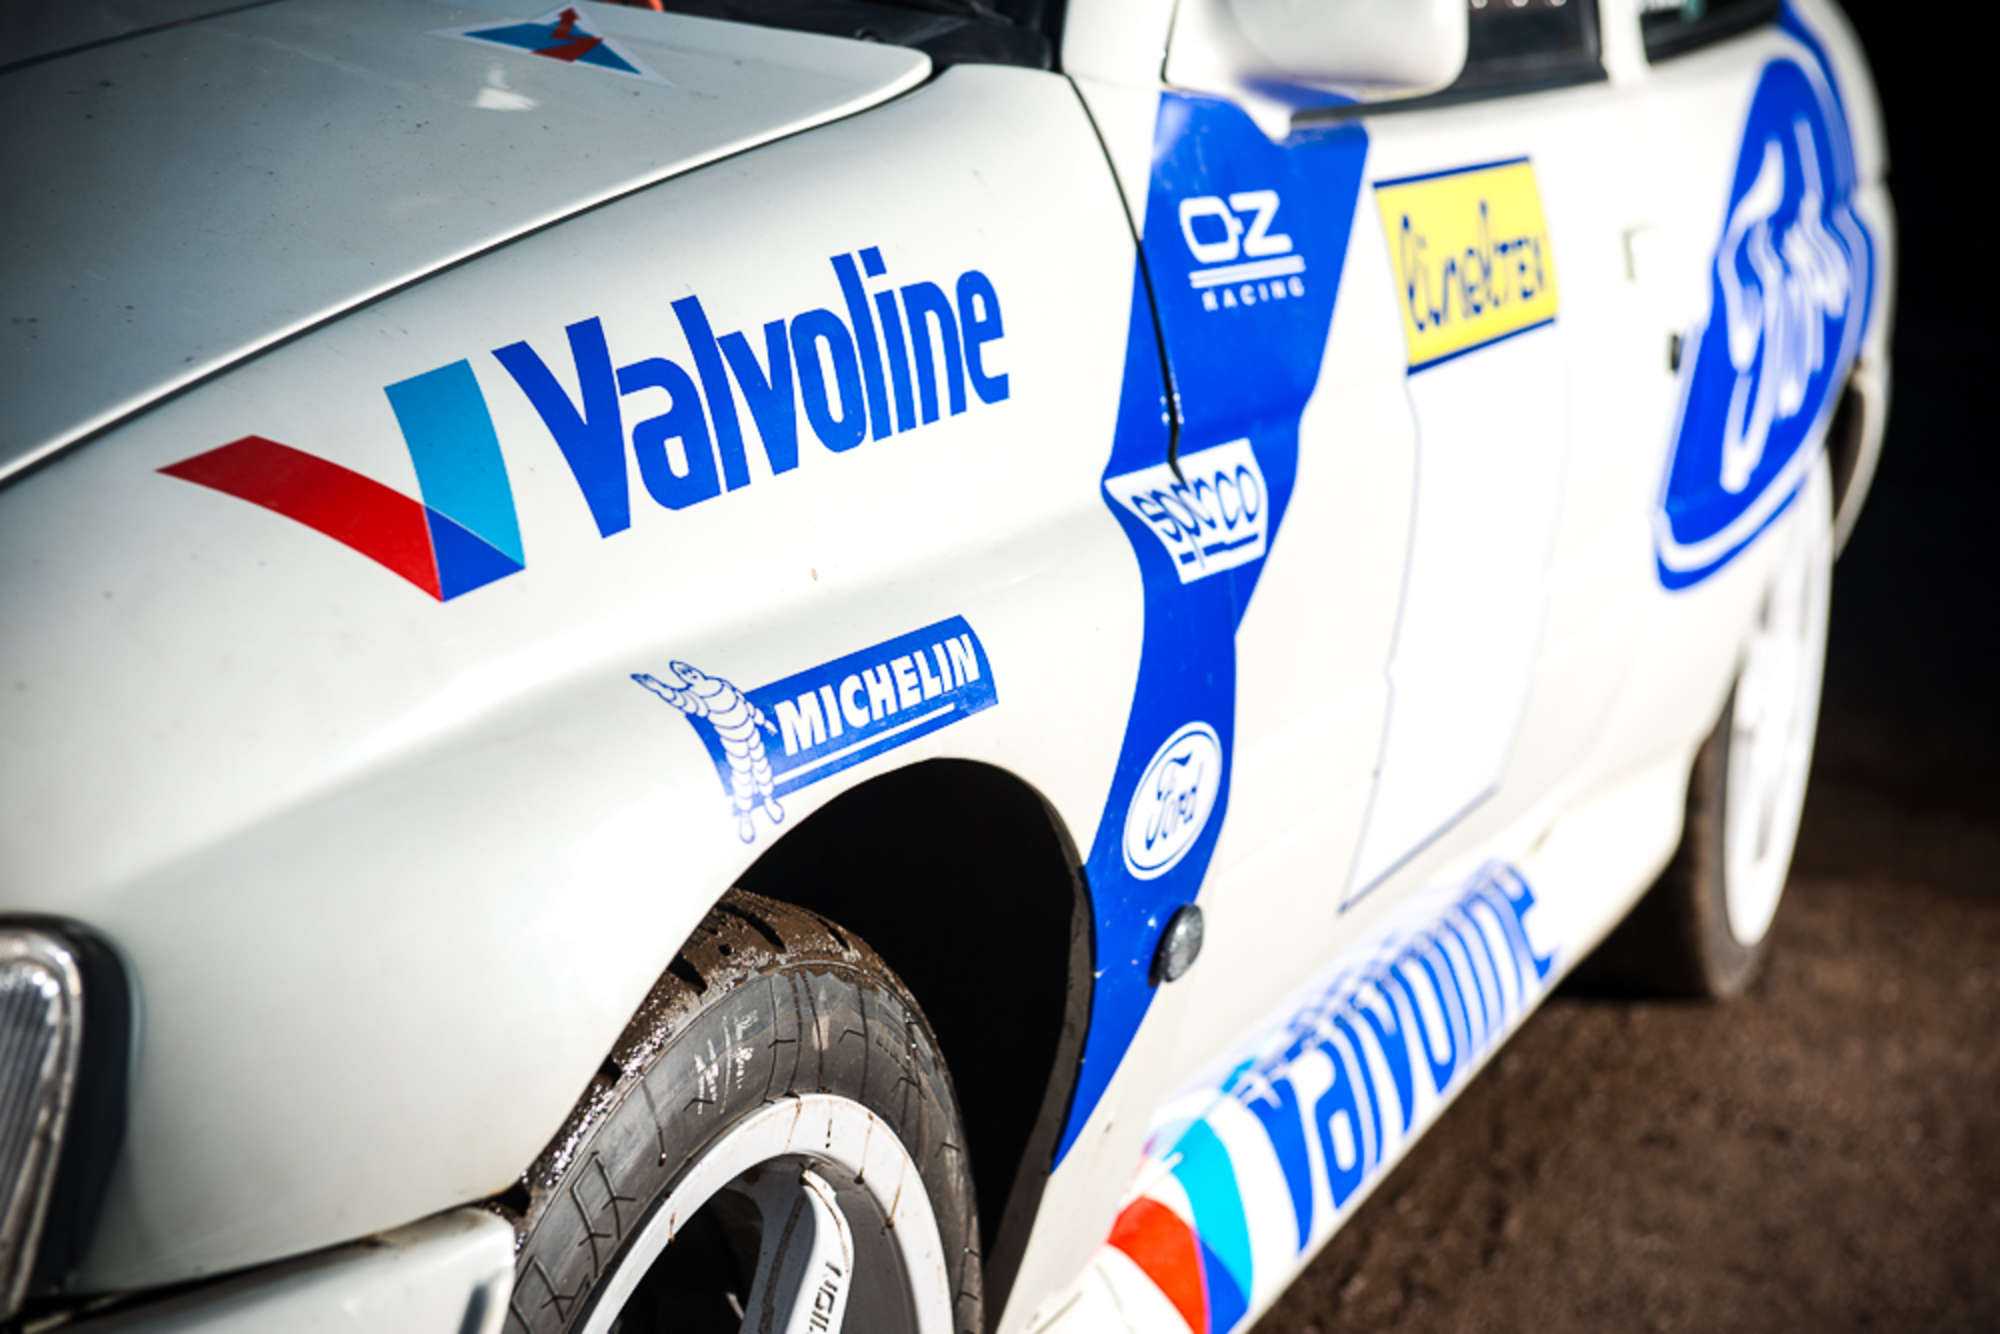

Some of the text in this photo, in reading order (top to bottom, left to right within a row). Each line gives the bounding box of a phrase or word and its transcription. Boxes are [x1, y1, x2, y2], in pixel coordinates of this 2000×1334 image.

[1202, 276, 1305, 312] RACING
[491, 246, 1009, 538] Valvoline
[774, 633, 980, 757] MICHELIN
[1145, 751, 1204, 851] Ford
